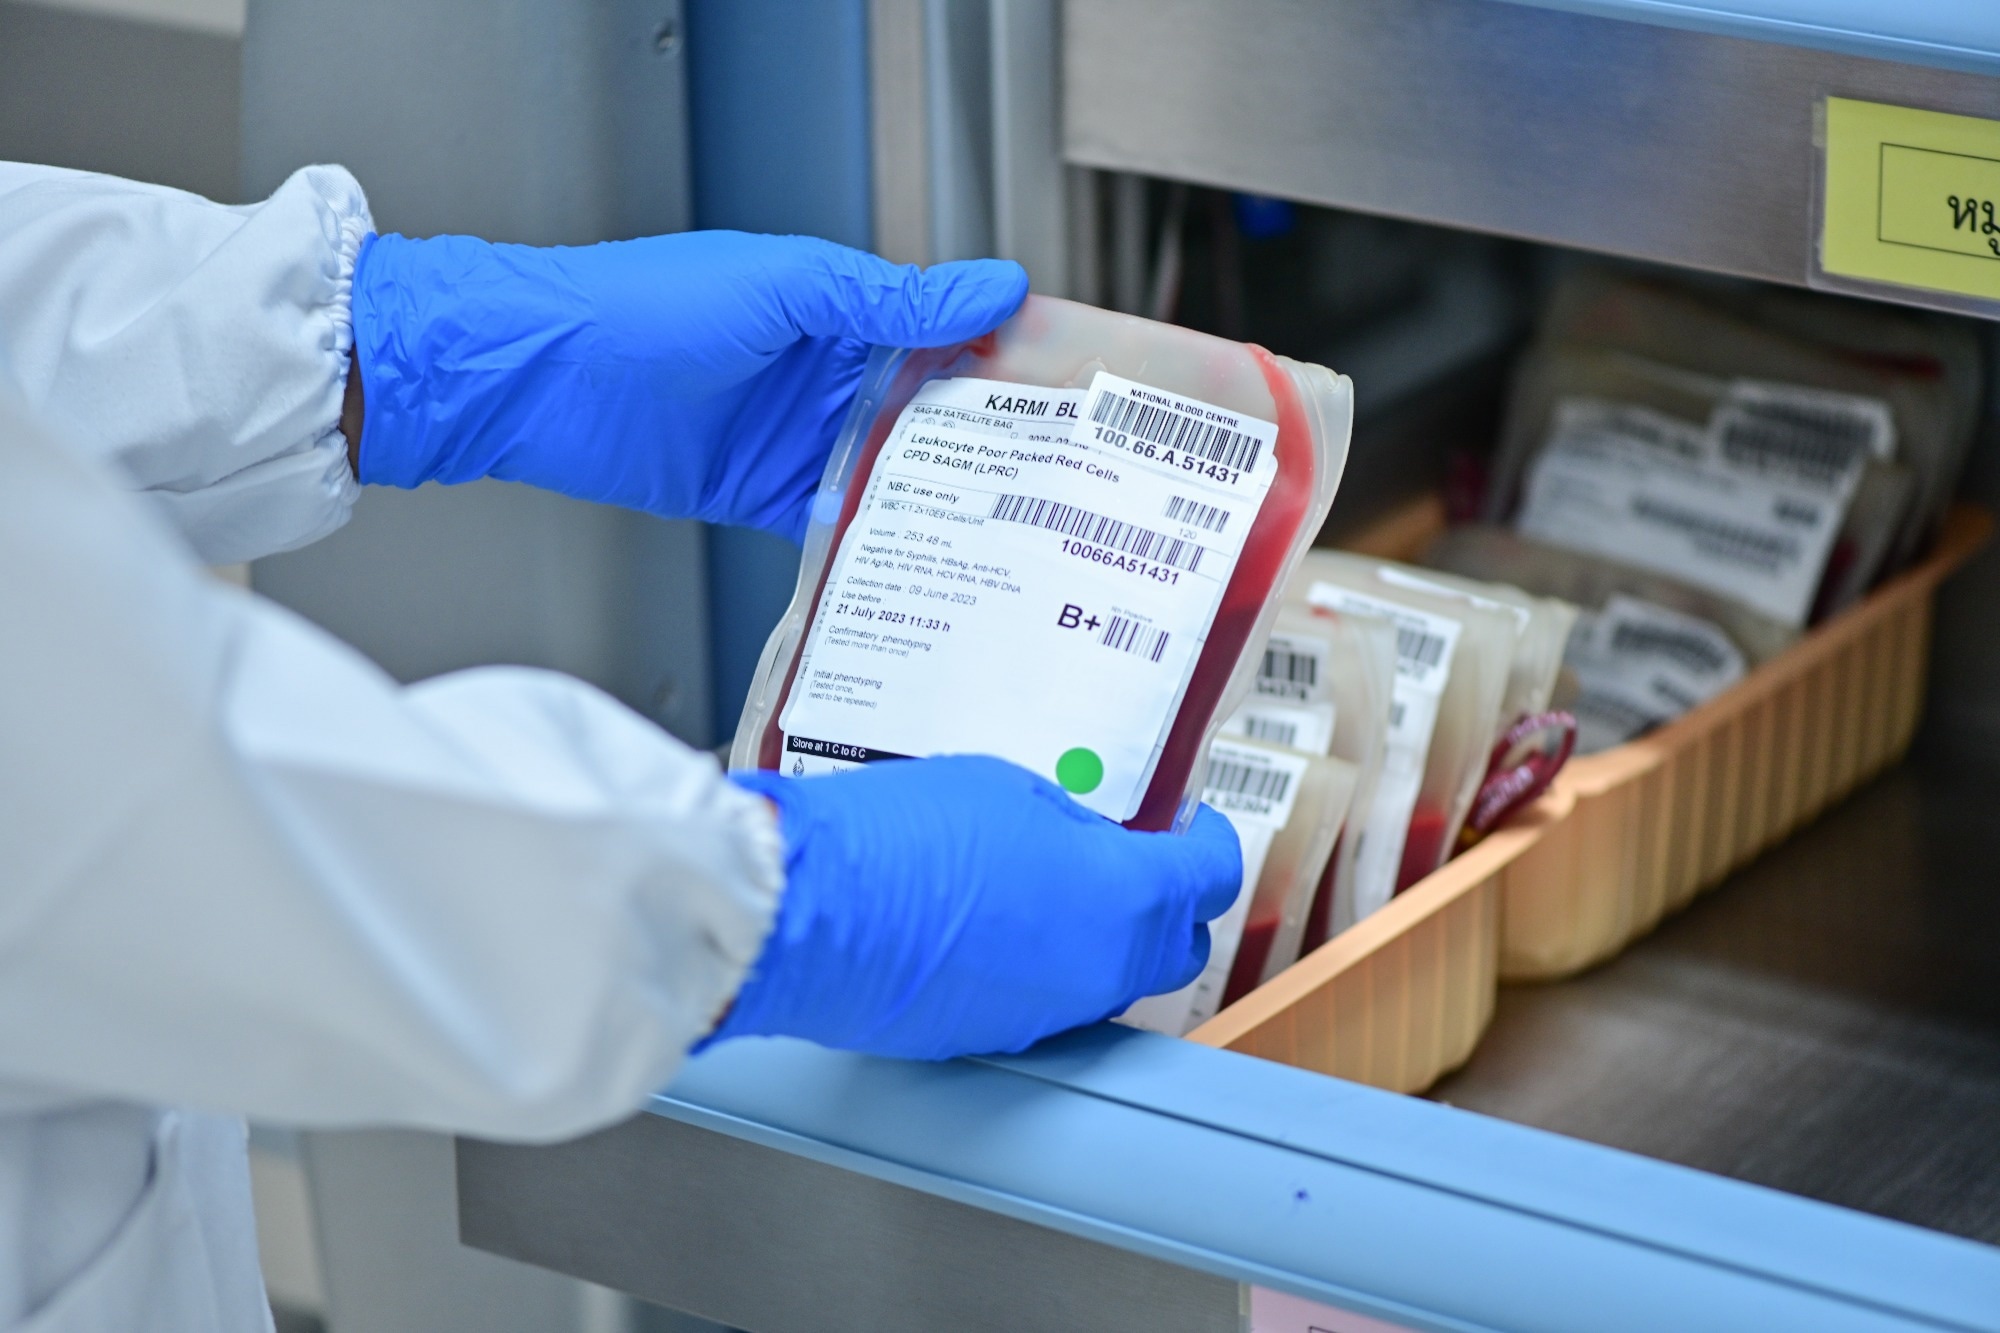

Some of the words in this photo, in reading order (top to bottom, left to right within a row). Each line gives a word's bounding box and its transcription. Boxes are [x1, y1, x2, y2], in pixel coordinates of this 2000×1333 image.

[913, 405, 941, 416] SAG-M
[942, 409, 991, 427] SATELLITE
[993, 417, 1013, 429] BAG
[985, 394, 1049, 417] KARMI
[1130, 388, 1172, 408] NATIONAL
[1174, 402, 1203, 417] BLOOD
[1205, 412, 1239, 428] CENTRE
[903, 450, 930, 462] CPD
[932, 454, 973, 471] SAGM
[974, 463, 1019, 480] (LPRC)
[910, 433, 975, 455] Leukocyte
[978, 445, 1007, 459] Poor
[1009, 450, 1053, 464] Packed
[1055, 454, 1083, 470] Red
[1086, 463, 1120, 483] Cells
[1094, 426, 1240, 485] 100.66.A.51431
[887, 481, 911, 492] NBC
[913, 488, 933, 497] use
[935, 491, 960, 504] only
[881, 501, 900, 510] WBC
[869, 527, 896, 538] Volume
[1178, 528, 1197, 540] 120
[861, 544, 893, 556] Negative
[894, 548, 904, 557] for
[1061, 538, 1180, 586] 10066A51431
[855, 555, 870, 565] HIV
[898, 562, 913, 572] HIV
[936, 569, 956, 580] HCV
[980, 577, 999, 589] HBV
[1001, 582, 1021, 594] DNA
[841, 590, 856, 599] Use
[857, 592, 882, 604] before
[846, 575, 883, 589] Collection
[884, 581, 901, 592] date
[908, 584, 922, 595] 09
[924, 587, 949, 600] June
[950, 592, 977, 606] 2023
[836, 603, 849, 614] 21
[851, 605, 876, 621] July
[878, 610, 906, 624] 2023
[909, 616, 940, 630] 11:33
[942, 622, 951, 632] h
[1057, 603, 1101, 631] B+
[824, 636, 850, 647] (Tested
[851, 641, 870, 650] more
[871, 643, 887, 653] than
[888, 648, 910, 659] once)
[828, 625, 879, 640] Confirmatory
[881, 634, 932, 652] phenotyping
[809, 680, 834, 691] (Tested
[835, 685, 854, 694] once,
[814, 669, 833, 680] Initial
[834, 672, 883, 690] phenotyping
[808, 692, 824, 700] need
[844, 697, 877, 709] repeated)
[792, 736, 813, 750] Store
[814, 741, 823, 751] at
[832, 744, 840, 754] C
[840, 745, 850, 755] to
[850, 746, 857, 757] 6
[858, 748, 866, 759] C
